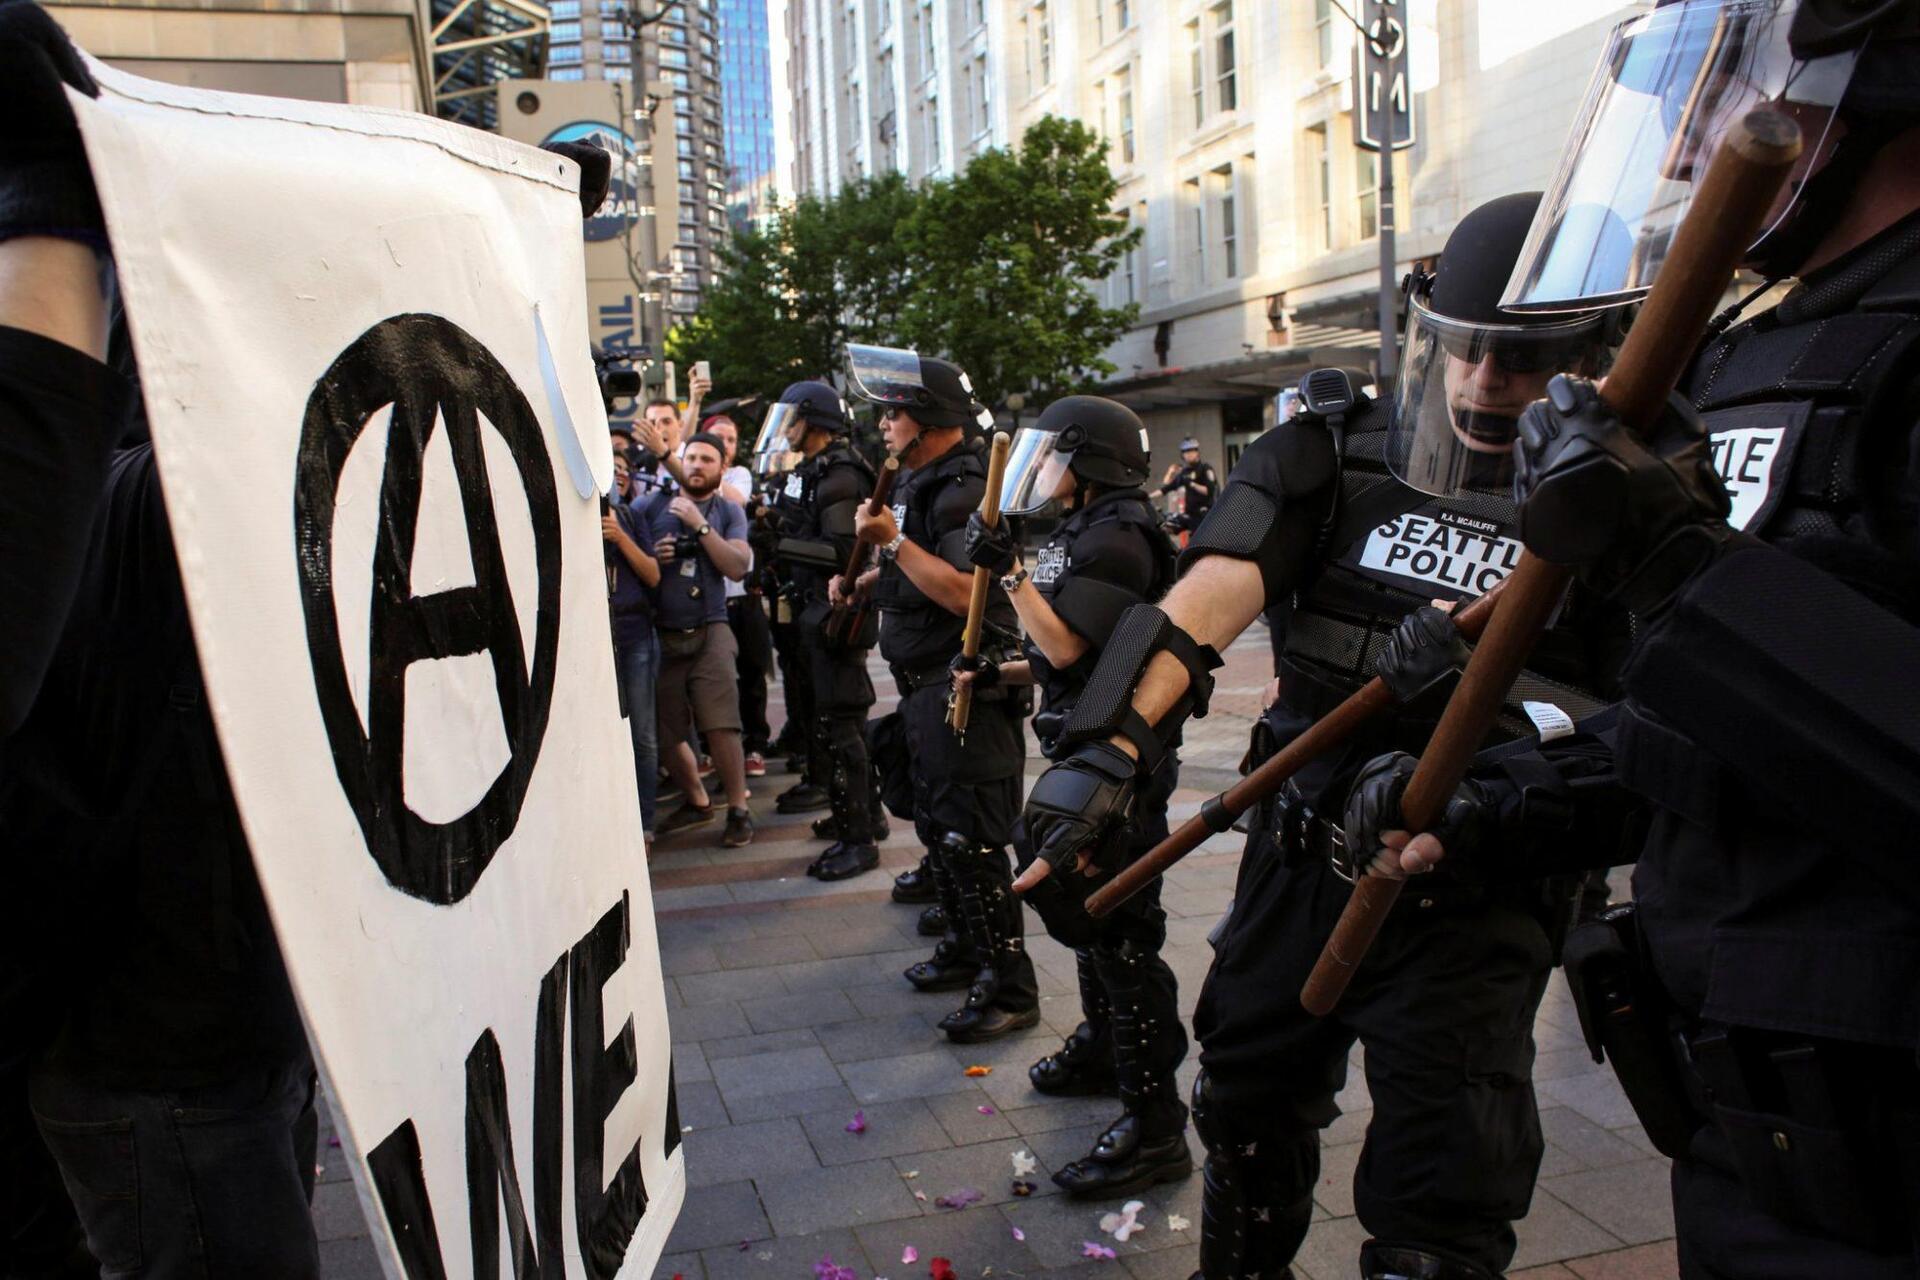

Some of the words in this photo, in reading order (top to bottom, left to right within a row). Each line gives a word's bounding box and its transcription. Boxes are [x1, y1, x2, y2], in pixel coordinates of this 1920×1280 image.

[1378, 515, 1519, 570] SEATTL
[1457, 517, 1497, 533] MCAULIFFE
[1385, 543, 1503, 593] POLIC
